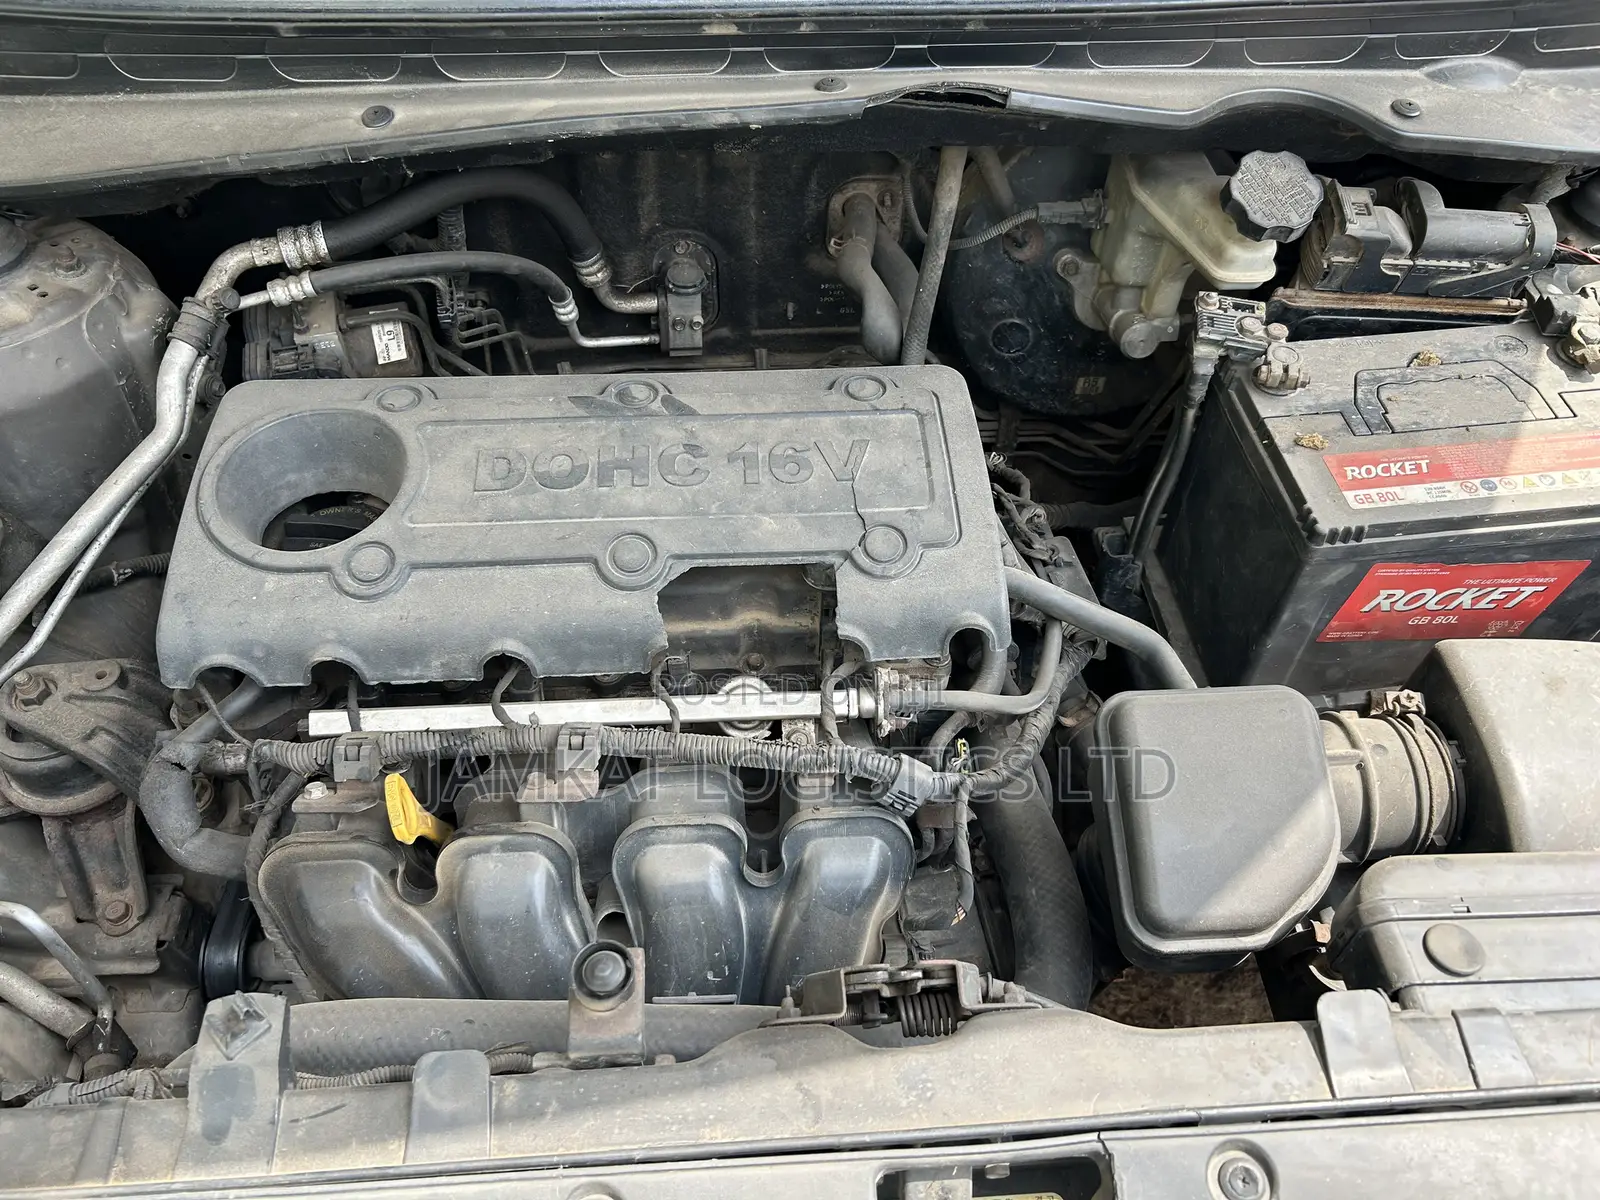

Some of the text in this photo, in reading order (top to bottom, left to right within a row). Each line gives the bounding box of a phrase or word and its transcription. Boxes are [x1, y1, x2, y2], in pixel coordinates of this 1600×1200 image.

[386, 330, 396, 341] L9
[473, 439, 871, 493] DOHC 16V
[1343, 459, 1431, 481] ROCKET
[1353, 490, 1405, 505] GB 80L
[1360, 585, 1548, 613] ROCKET
[1408, 615, 1459, 625] GB 80L
